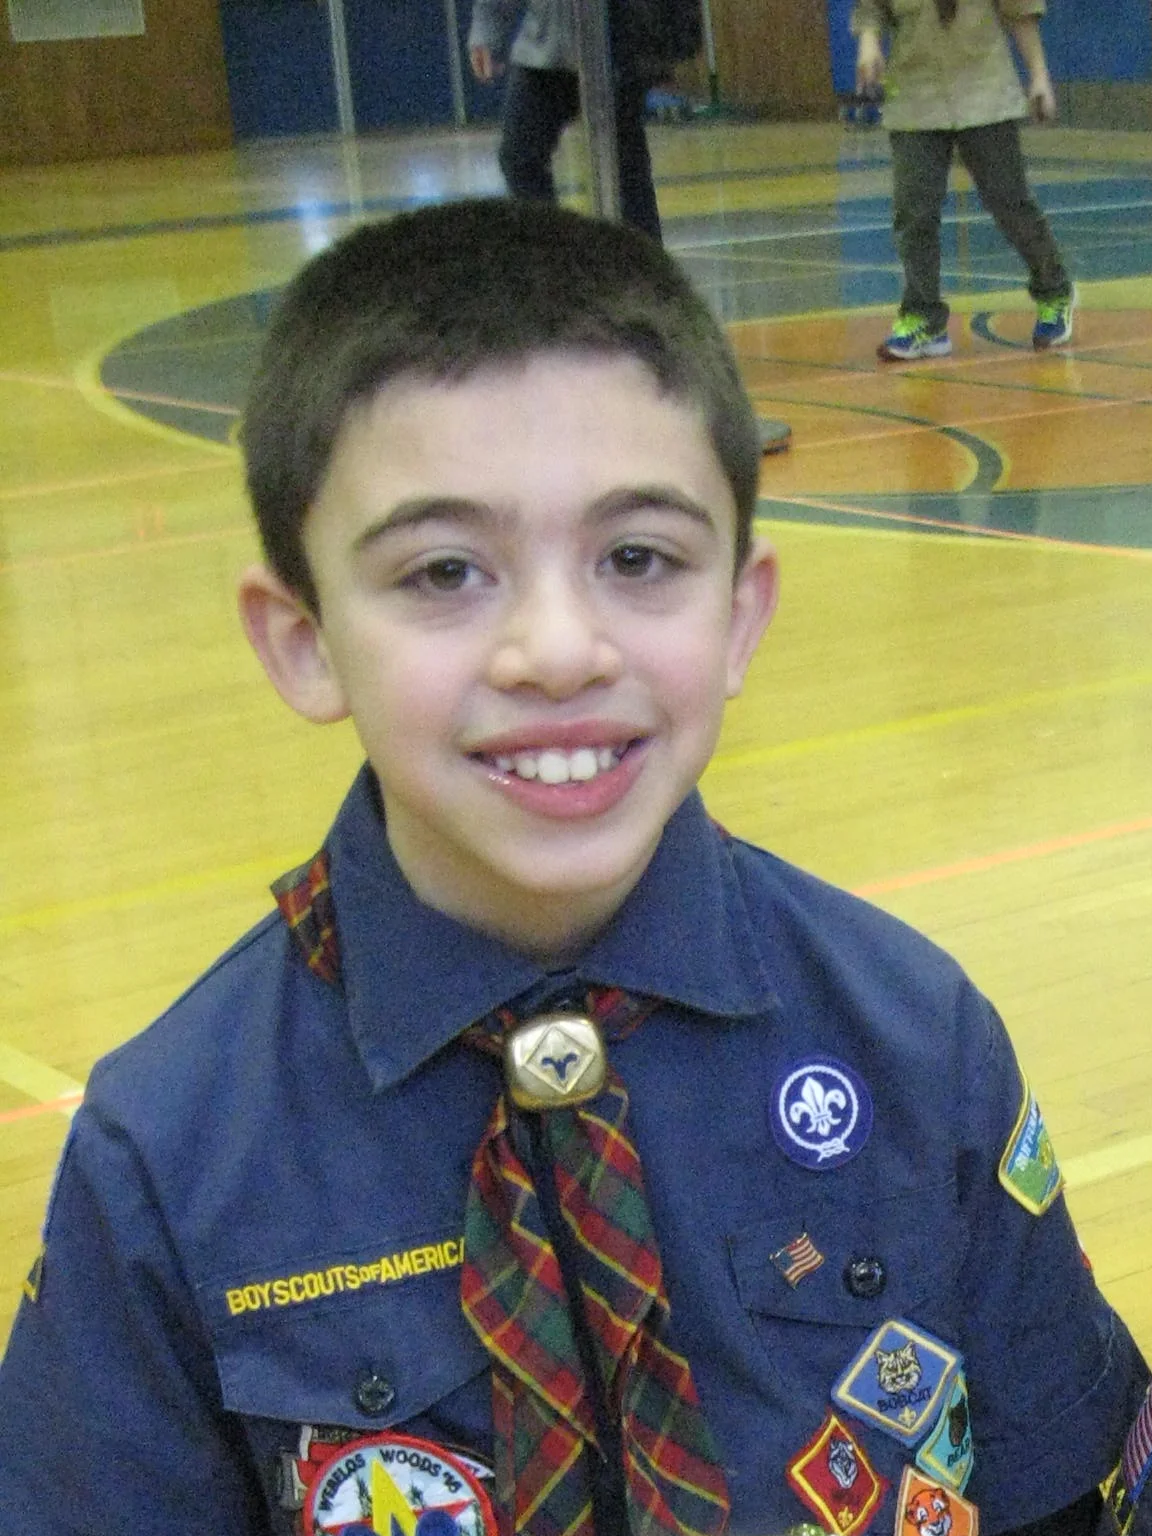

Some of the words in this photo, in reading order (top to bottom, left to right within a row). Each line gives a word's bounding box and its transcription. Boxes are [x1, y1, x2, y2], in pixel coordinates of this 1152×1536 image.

[226, 1282, 271, 1315] BOY
[272, 1265, 361, 1306] SCOUTS
[318, 1453, 366, 1512] WEBELOS
[379, 1449, 442, 1478] WOODS
